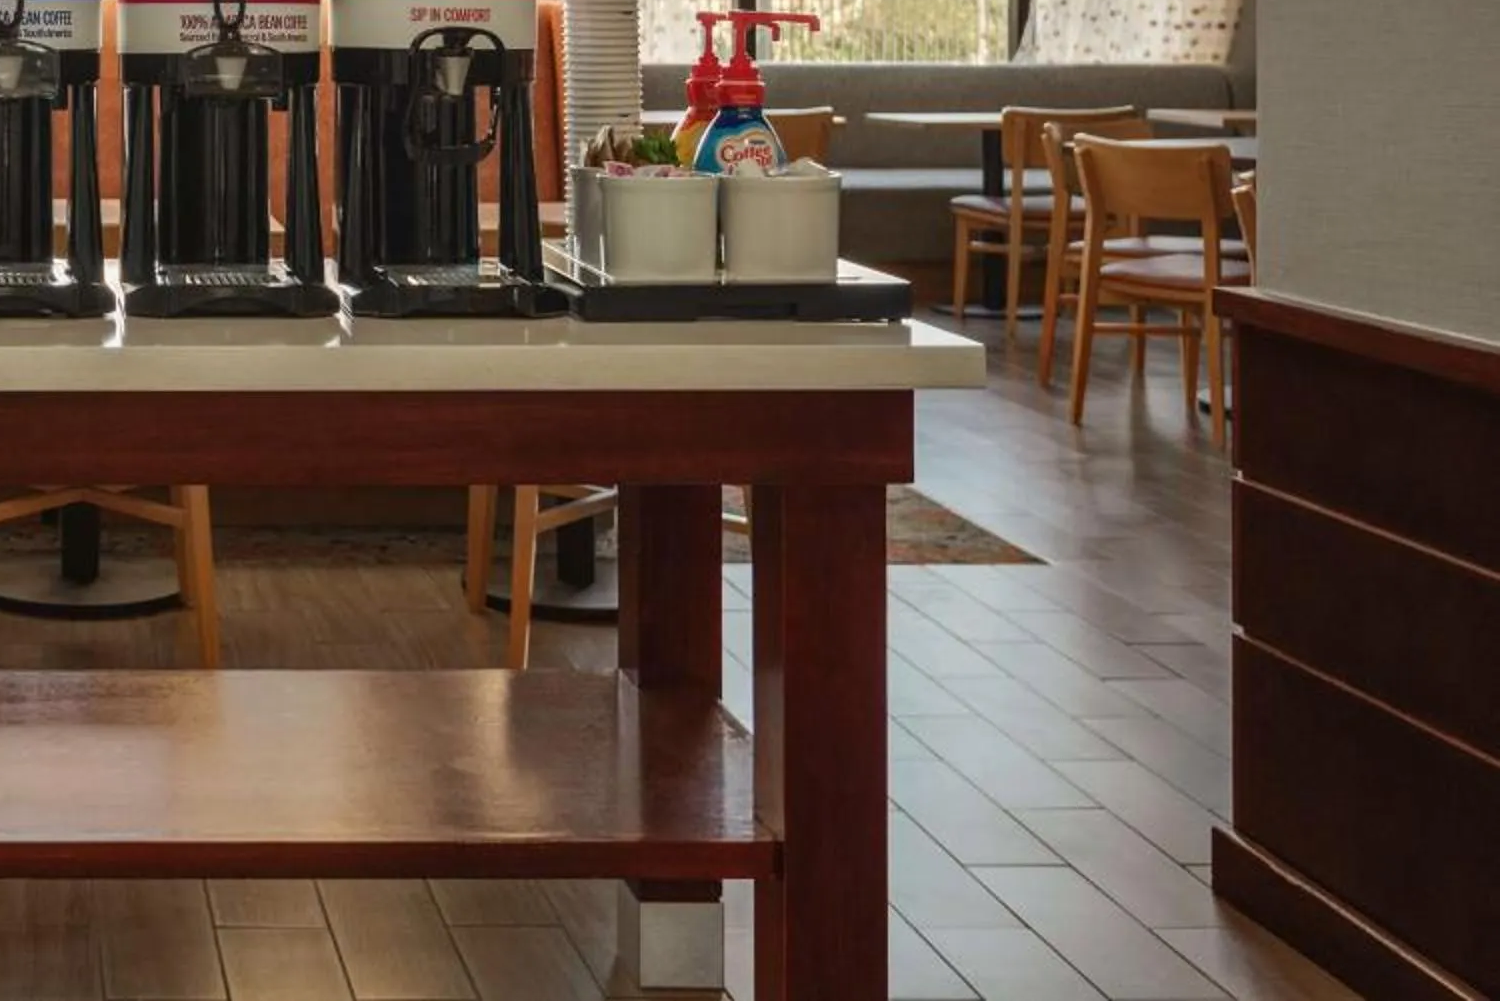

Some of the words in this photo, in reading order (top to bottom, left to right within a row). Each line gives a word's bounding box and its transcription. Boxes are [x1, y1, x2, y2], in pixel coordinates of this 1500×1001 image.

[42, 9, 72, 25] COFFEE
[430, 7, 441, 22] IN
[443, 7, 491, 22] COMFORT
